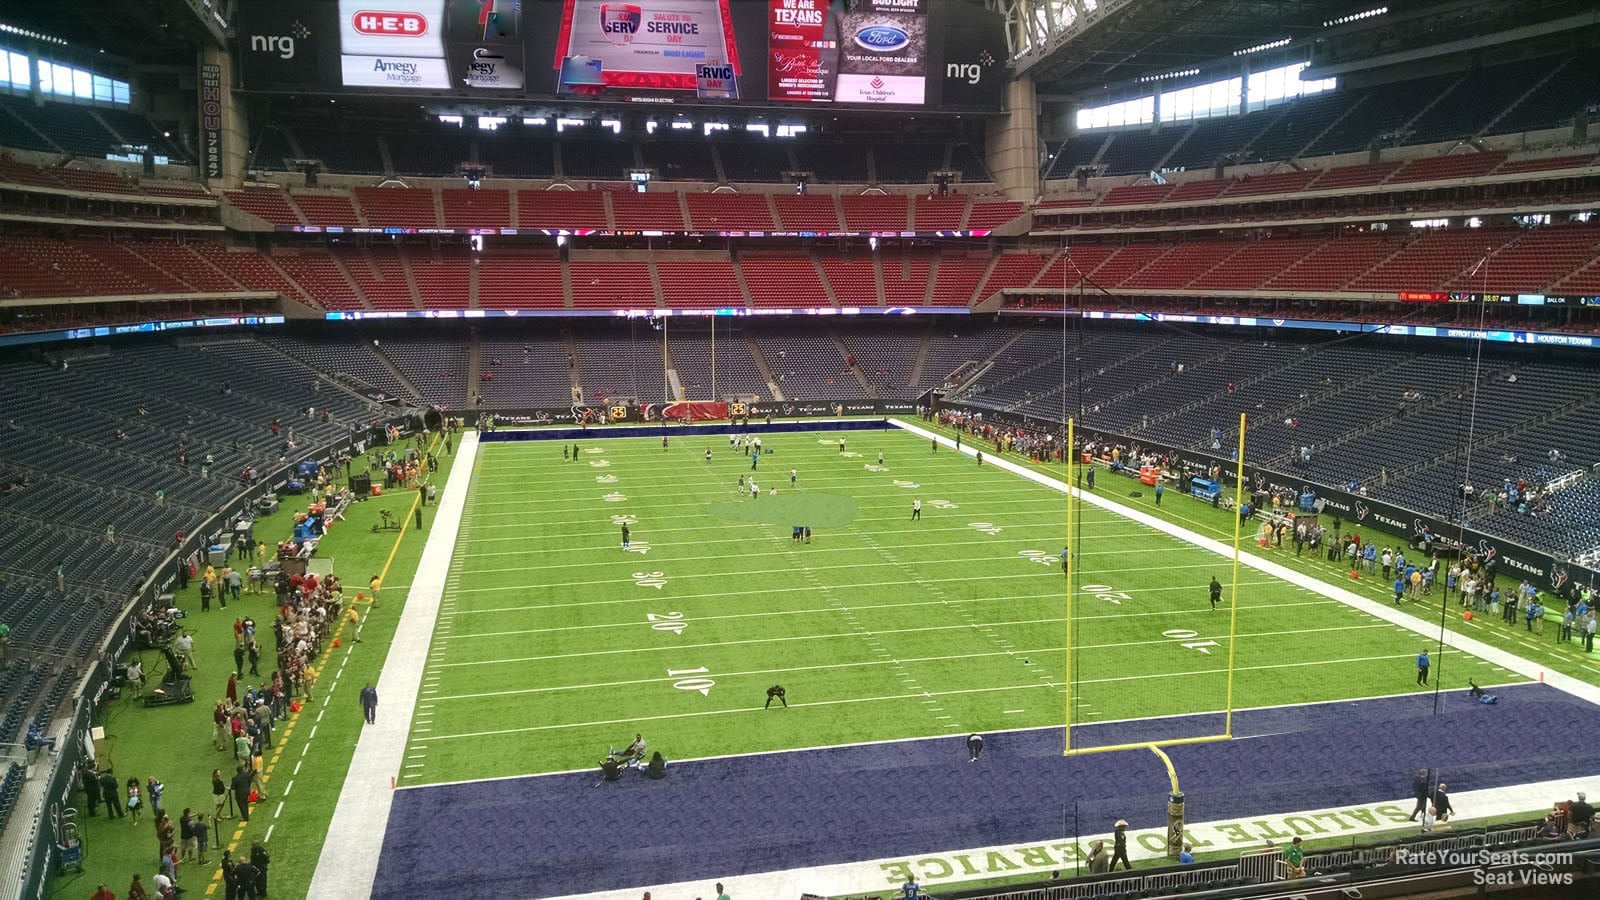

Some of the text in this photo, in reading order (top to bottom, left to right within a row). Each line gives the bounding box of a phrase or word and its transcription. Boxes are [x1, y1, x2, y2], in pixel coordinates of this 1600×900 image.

[783, 0, 815, 9] WE ARE
[653, 13, 679, 21] SALUTE
[775, 9, 822, 23] TEXANS
[647, 21, 699, 34] SERVICE
[868, 31, 897, 44] Ford
[251, 35, 294, 59] nrg
[374, 58, 417, 74] Amegy
[947, 63, 981, 84] nrg
[386, 73, 421, 82] Mortgage
[707, 80, 722, 88] DAY
[203, 87, 220, 130] HOU
[1448, 329, 1488, 339] DETROIT LIONS
[1537, 335, 1593, 346] HOUSTON TEXANS
[612, 408, 624, 417] 25
[733, 405, 744, 414] 25
[1182, 459, 1207, 470] TEXANS
[1374, 513, 1407, 530] TEXANS
[1502, 556, 1544, 577] TEXANS
[632, 571, 667, 587] 30
[1080, 585, 1133, 601] 20
[646, 611, 688, 631] 20
[1162, 629, 1221, 650] 10
[667, 666, 716, 690] 10
[1214, 804, 1411, 844] SALUTE
[1136, 828, 1214, 853] TO
